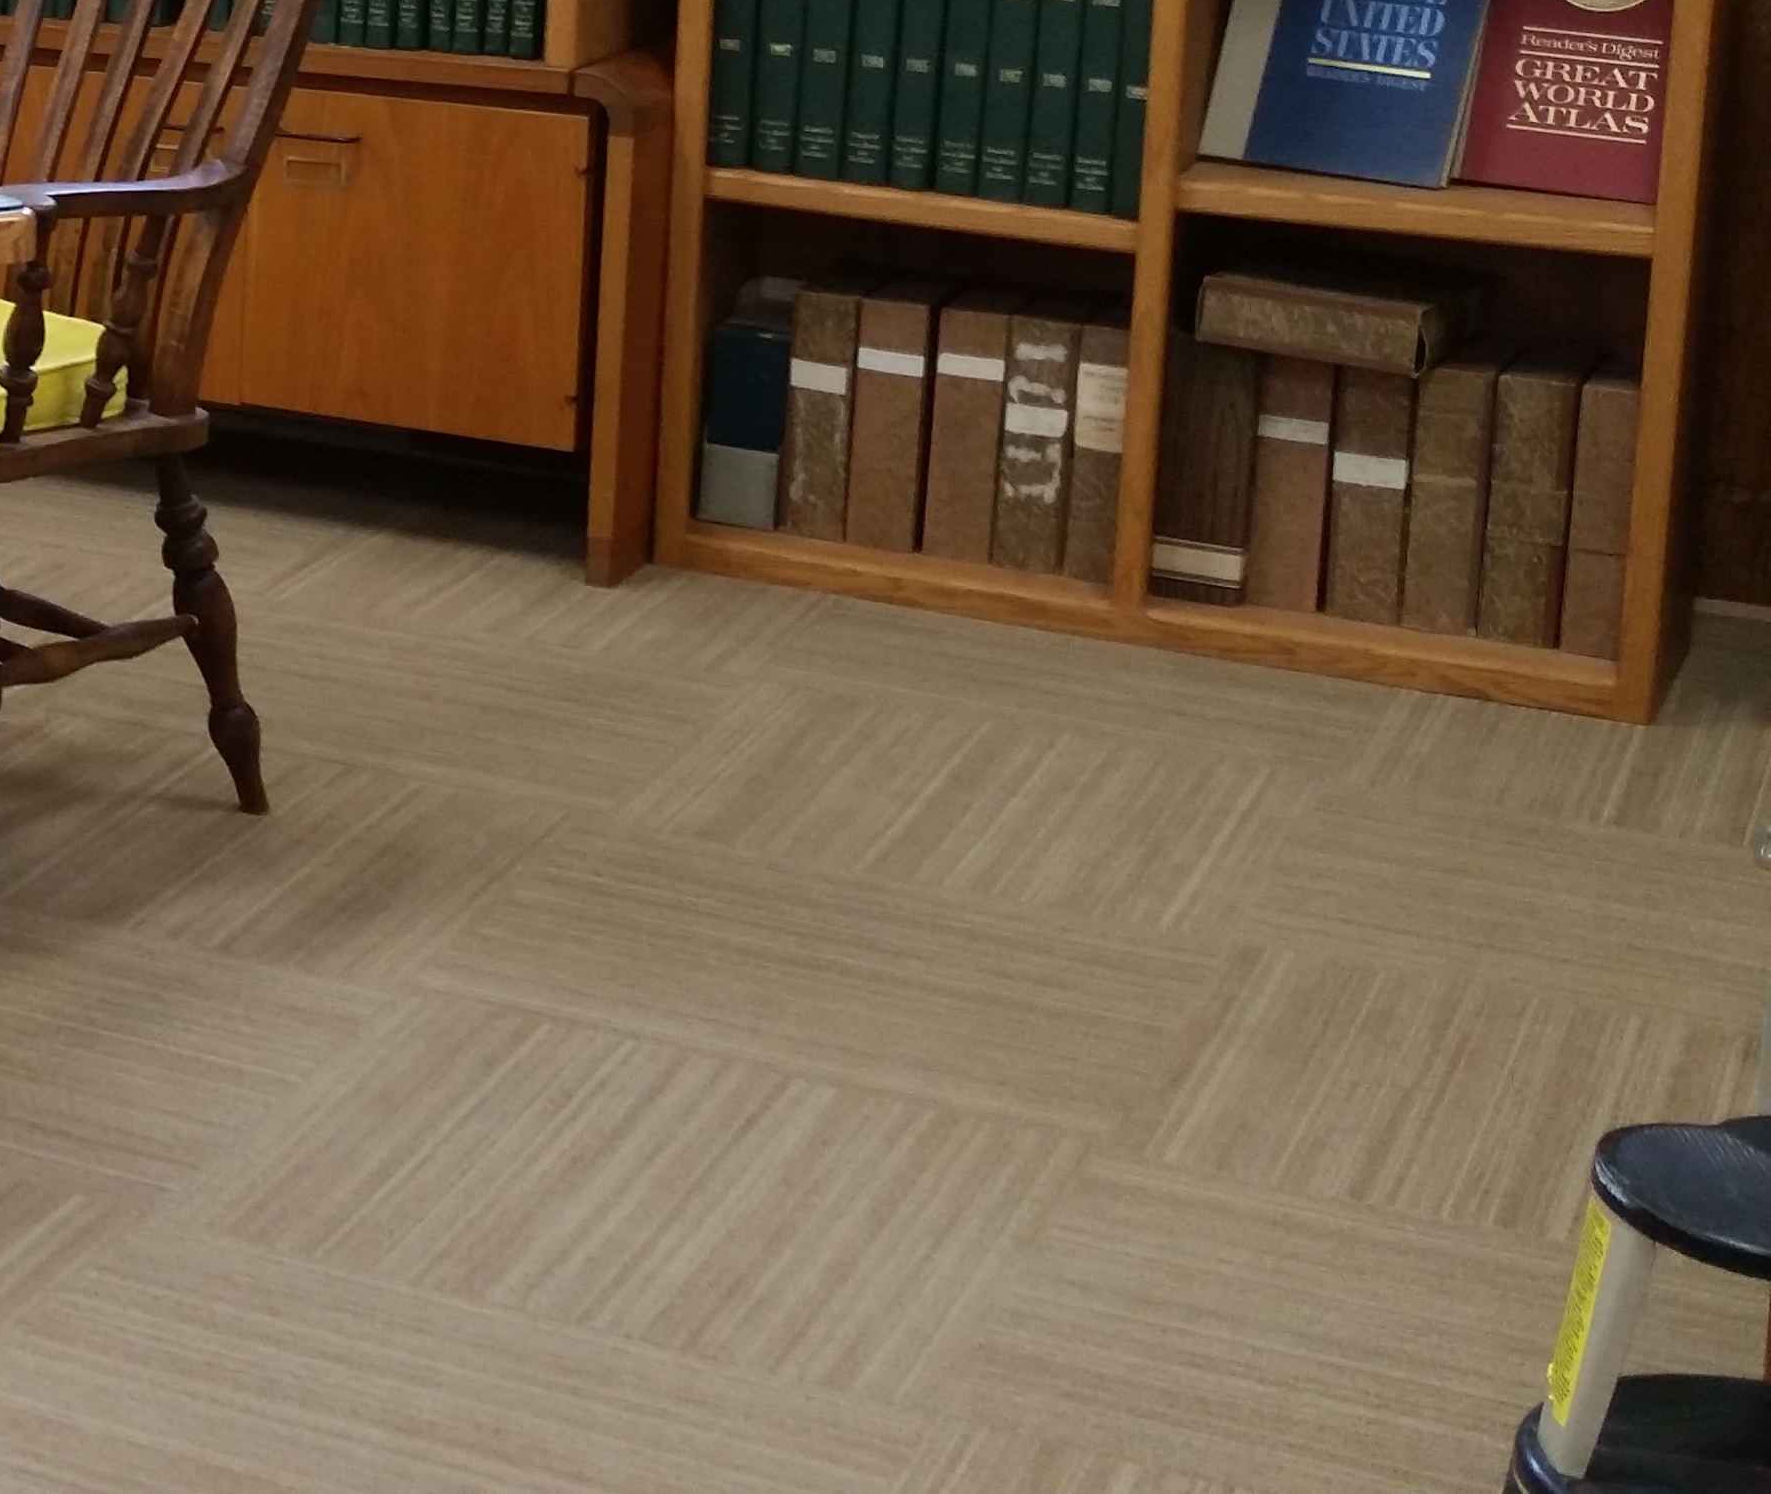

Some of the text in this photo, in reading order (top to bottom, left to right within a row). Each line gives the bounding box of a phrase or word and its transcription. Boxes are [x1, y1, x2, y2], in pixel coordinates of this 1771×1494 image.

[1310, 27, 1439, 69] STATES
[1521, 33, 1662, 62] Reader's Digest
[1514, 58, 1658, 91] GREAT
[1514, 79, 1656, 113] WORLD
[1508, 104, 1650, 136] ATLAS
